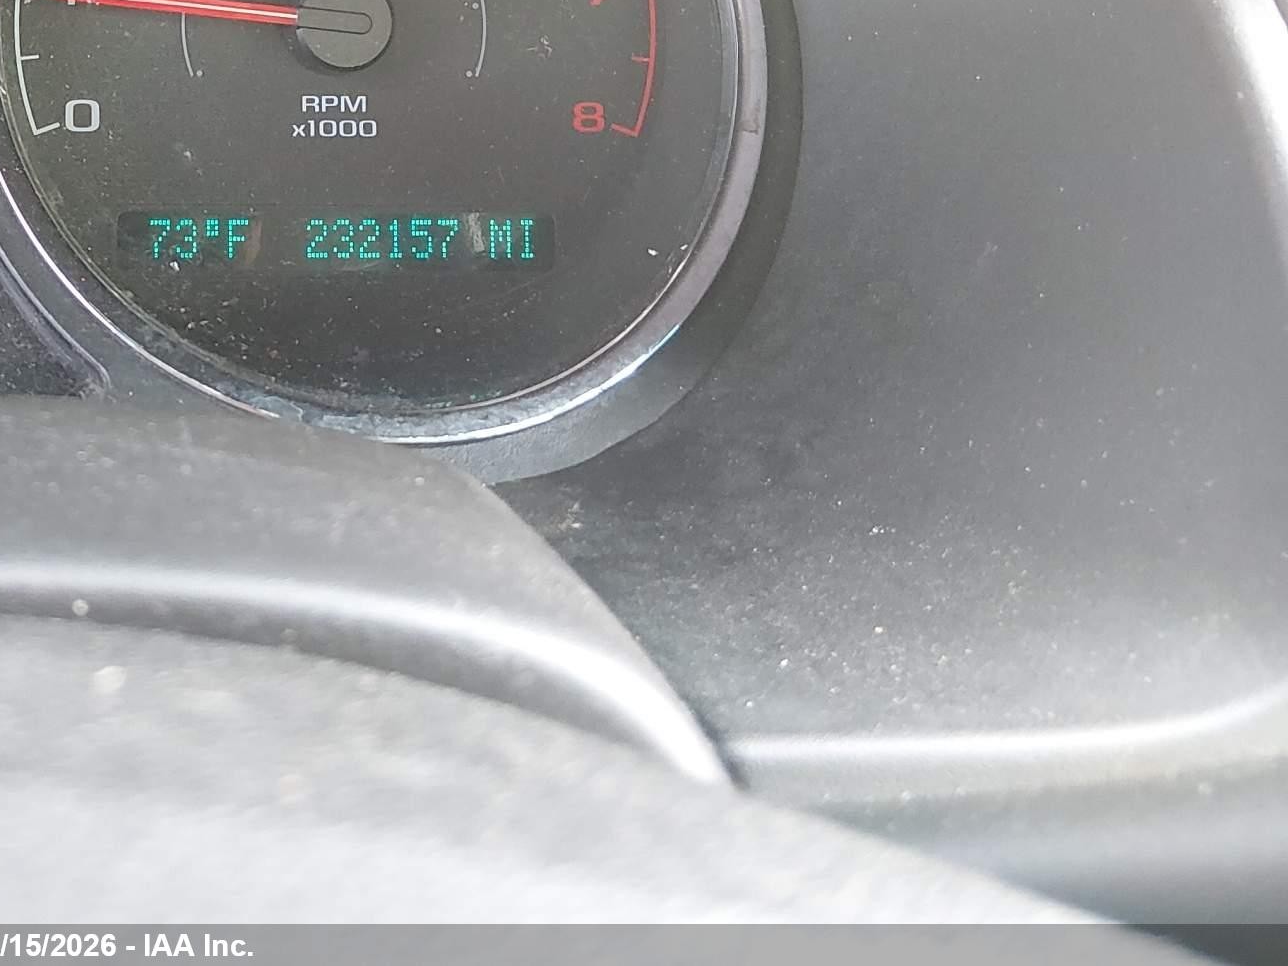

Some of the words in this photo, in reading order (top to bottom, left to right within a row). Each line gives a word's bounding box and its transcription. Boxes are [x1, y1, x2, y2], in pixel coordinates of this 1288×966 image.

[65, 99, 100, 132] 0
[301, 95, 367, 113] RPM
[572, 102, 606, 133] 8
[292, 120, 378, 138] x1000
[306, 218, 459, 259] 232157
[490, 218, 535, 259] MI
